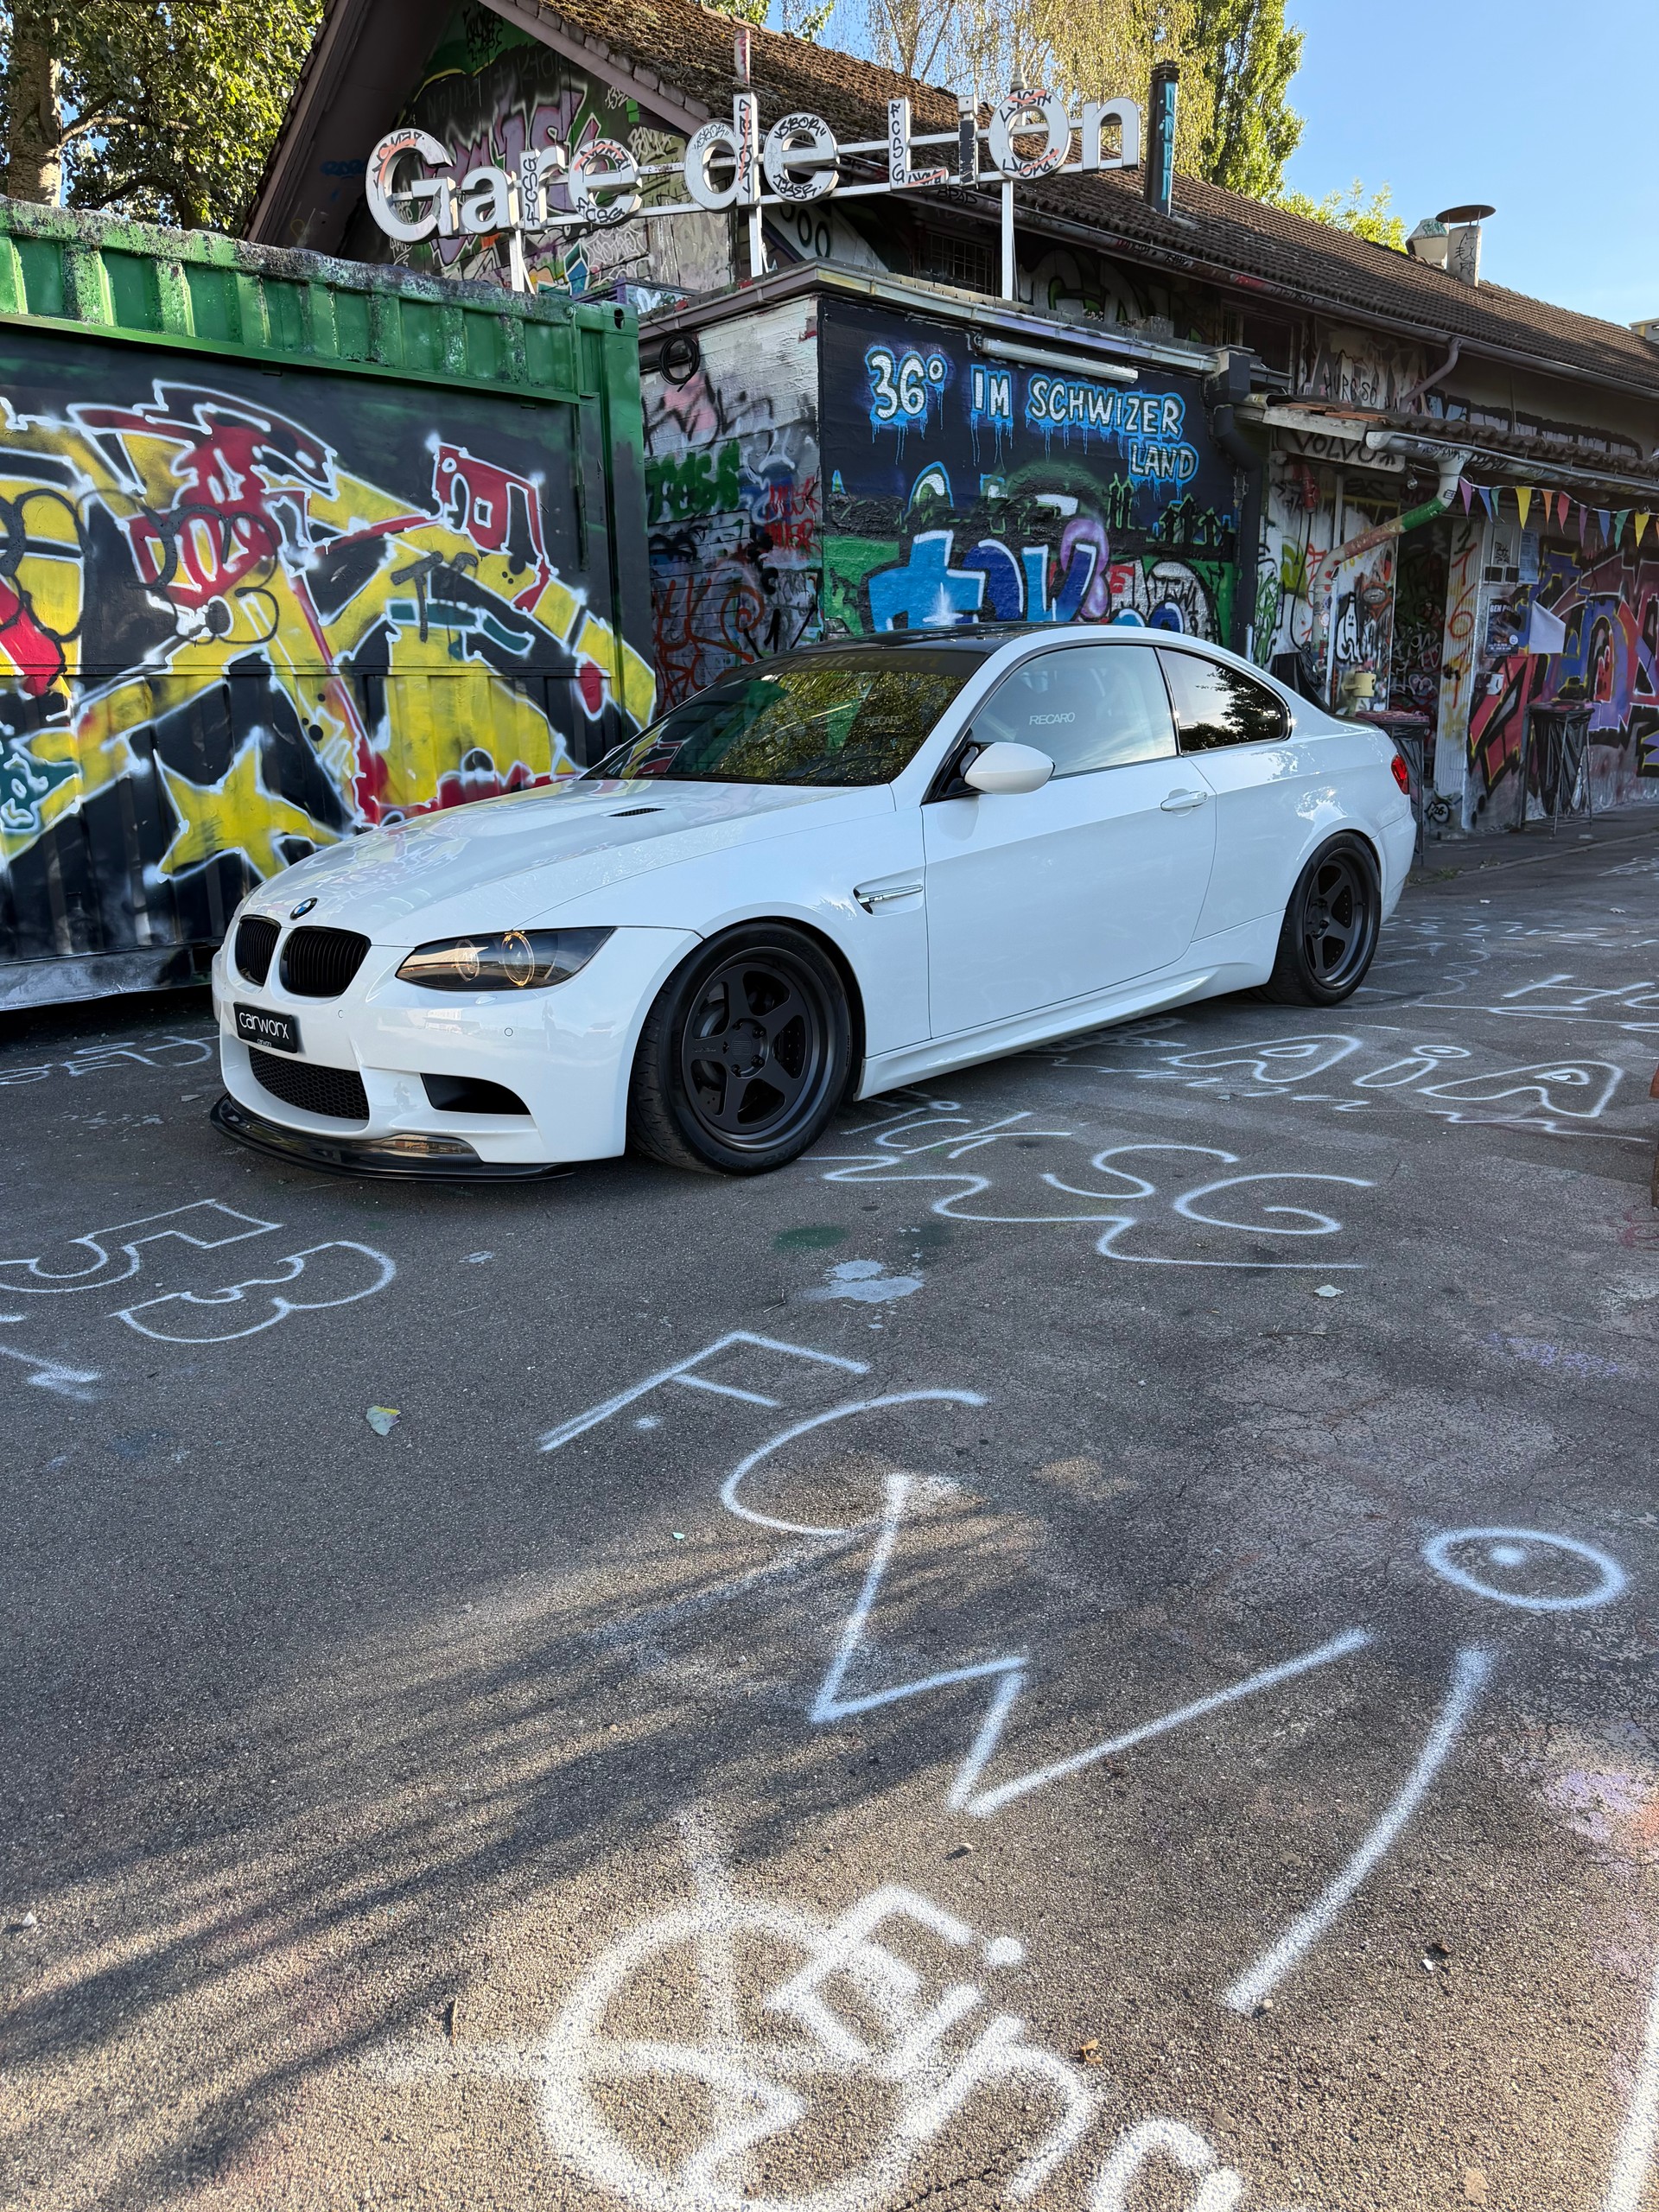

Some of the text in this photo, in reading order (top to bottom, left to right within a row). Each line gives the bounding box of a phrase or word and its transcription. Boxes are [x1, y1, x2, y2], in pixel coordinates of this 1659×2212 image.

[889, 102, 906, 185] FCSG
[365, 127, 642, 244] Gare
[684, 92, 838, 212] de
[522, 157, 539, 226] FCSG
[576, 196, 626, 223] FCSG
[971, 365, 1012, 420] IM
[1027, 373, 1186, 438] SCHWIZER
[1128, 437, 1200, 484] LAND
[1291, 431, 1379, 462] VOLVO
[864, 715, 904, 728] RECARO
[1029, 712, 1076, 725] RECARO
[238, 1012, 289, 1039] carworx
